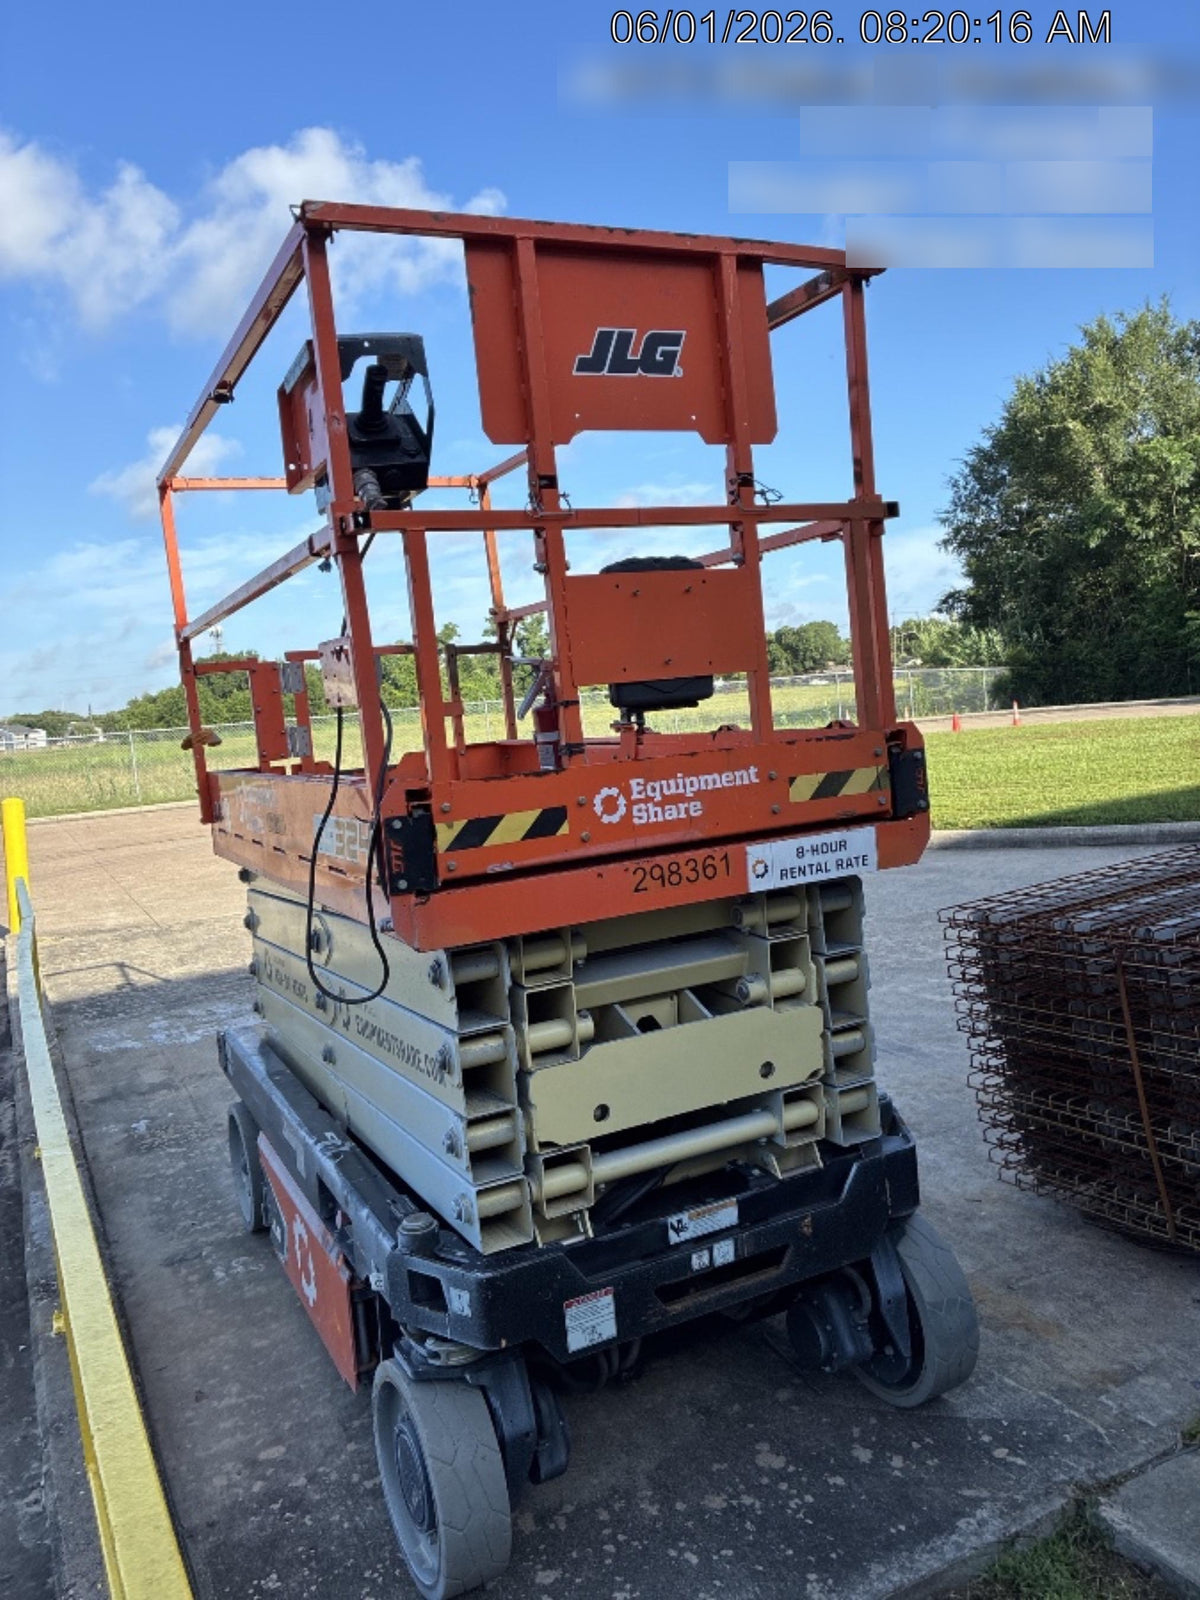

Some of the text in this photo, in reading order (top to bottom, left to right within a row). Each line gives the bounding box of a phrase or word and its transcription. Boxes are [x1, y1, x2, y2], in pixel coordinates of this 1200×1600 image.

[572, 327, 687, 377] JLG
[629, 765, 759, 801] Equipment
[632, 800, 703, 825] Share
[796, 839, 848, 859] 8-HOUR
[632, 852, 731, 893] 298361
[780, 854, 869, 880] RENTAL RATE
